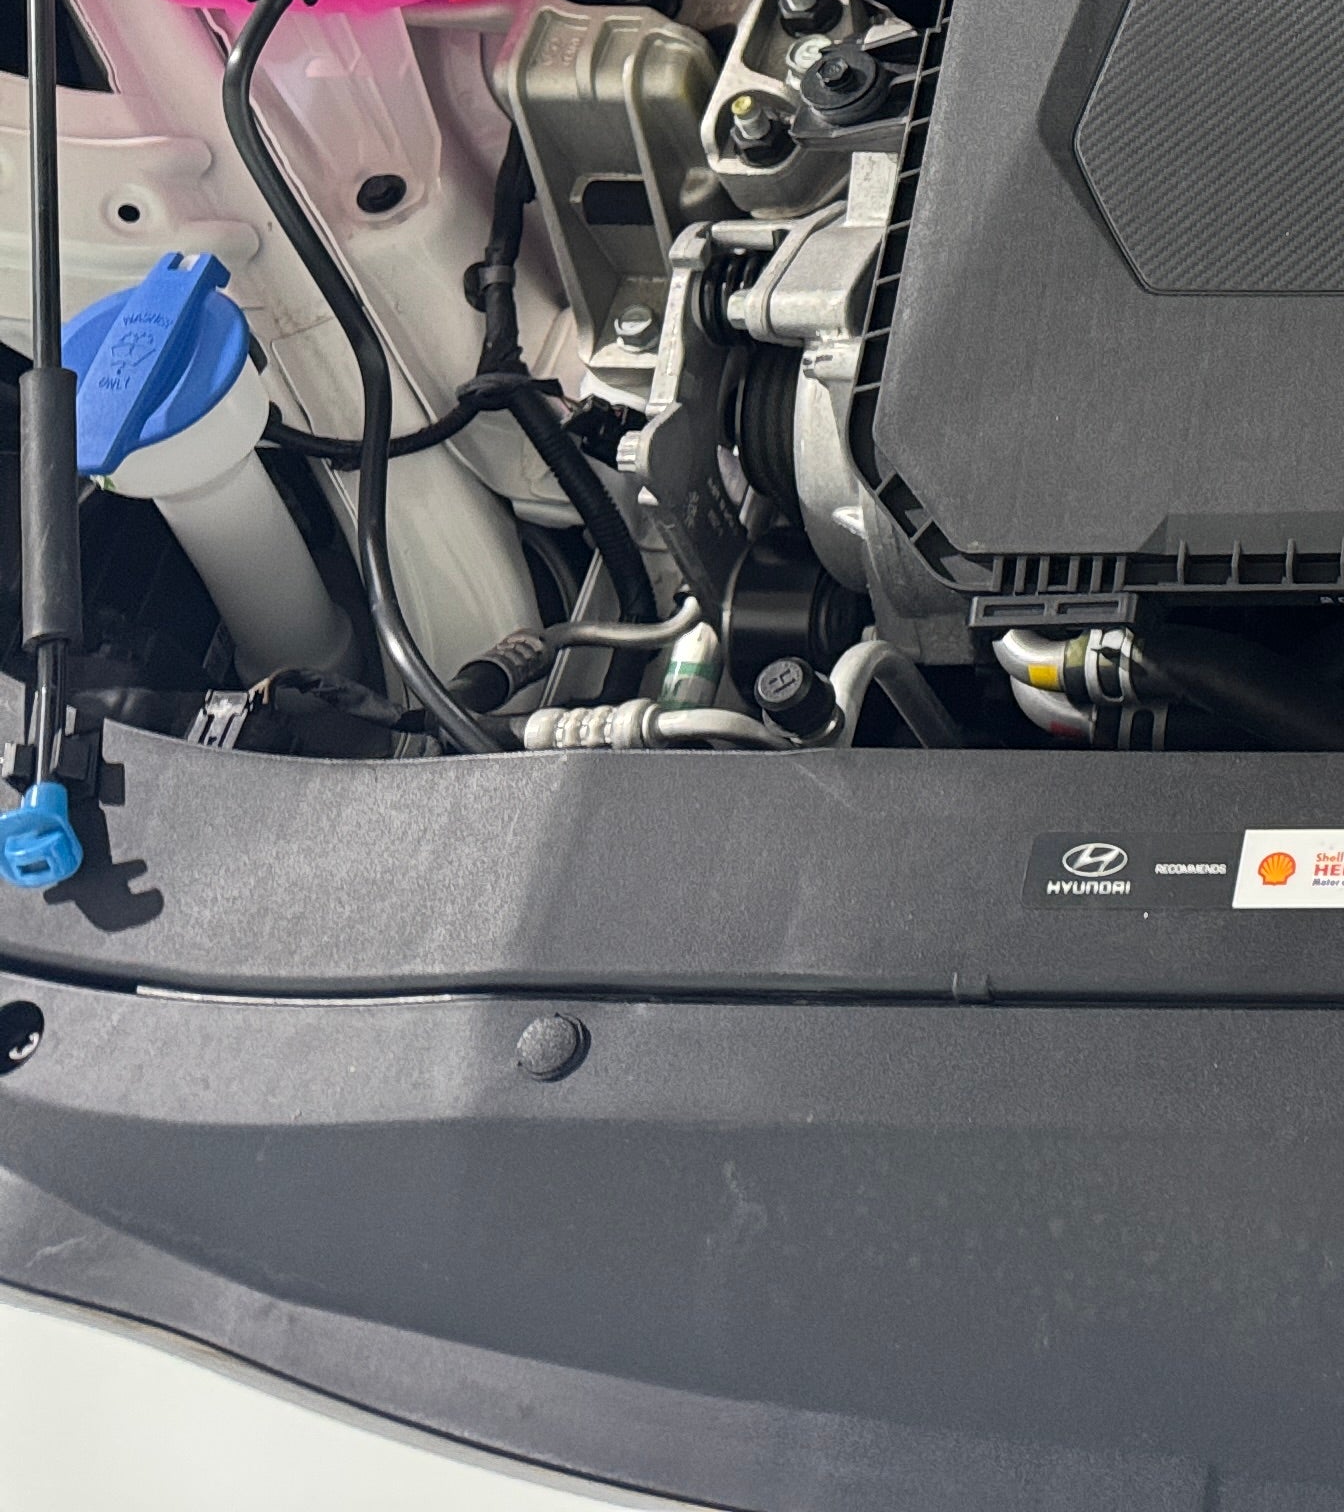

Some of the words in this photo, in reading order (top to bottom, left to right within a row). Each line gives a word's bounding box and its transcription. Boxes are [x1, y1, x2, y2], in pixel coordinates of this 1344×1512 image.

[1316, 851, 1344, 863] Shell
[1154, 863, 1227, 875] RECOMMENDS
[1046, 880, 1131, 895] HYUNDAI
